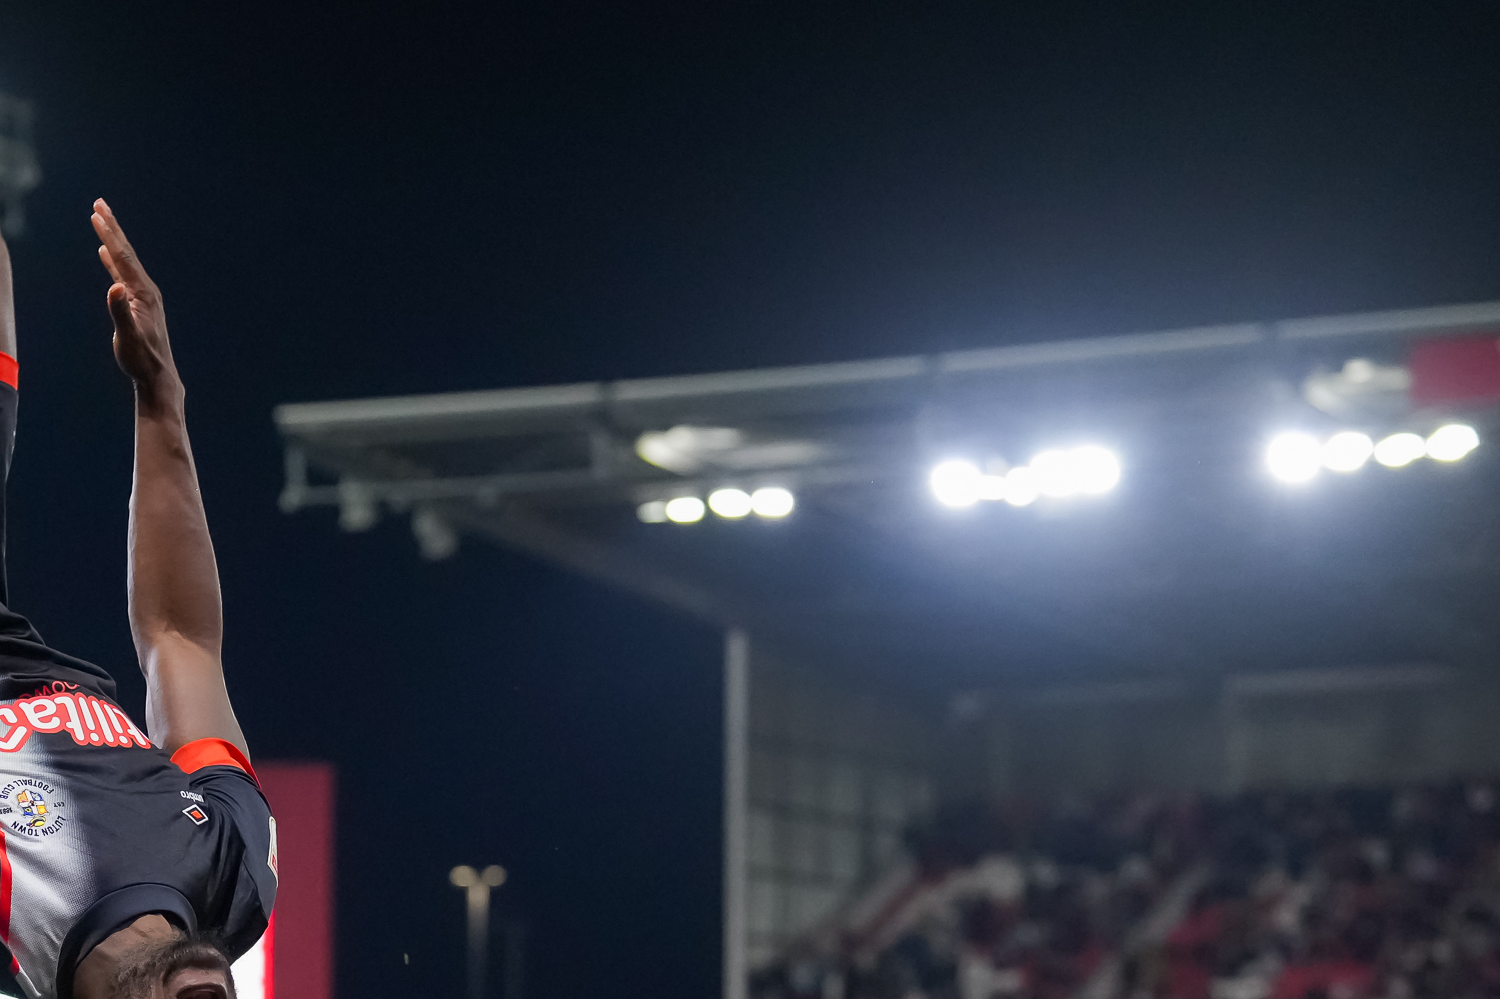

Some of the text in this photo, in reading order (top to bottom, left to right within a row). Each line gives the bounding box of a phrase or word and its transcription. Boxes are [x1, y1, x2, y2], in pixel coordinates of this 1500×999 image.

[17, 693, 150, 748] tilita
[0, 779, 55, 800] FOOTBALL CLUB
[11, 815, 67, 837] LUTON TOWN
